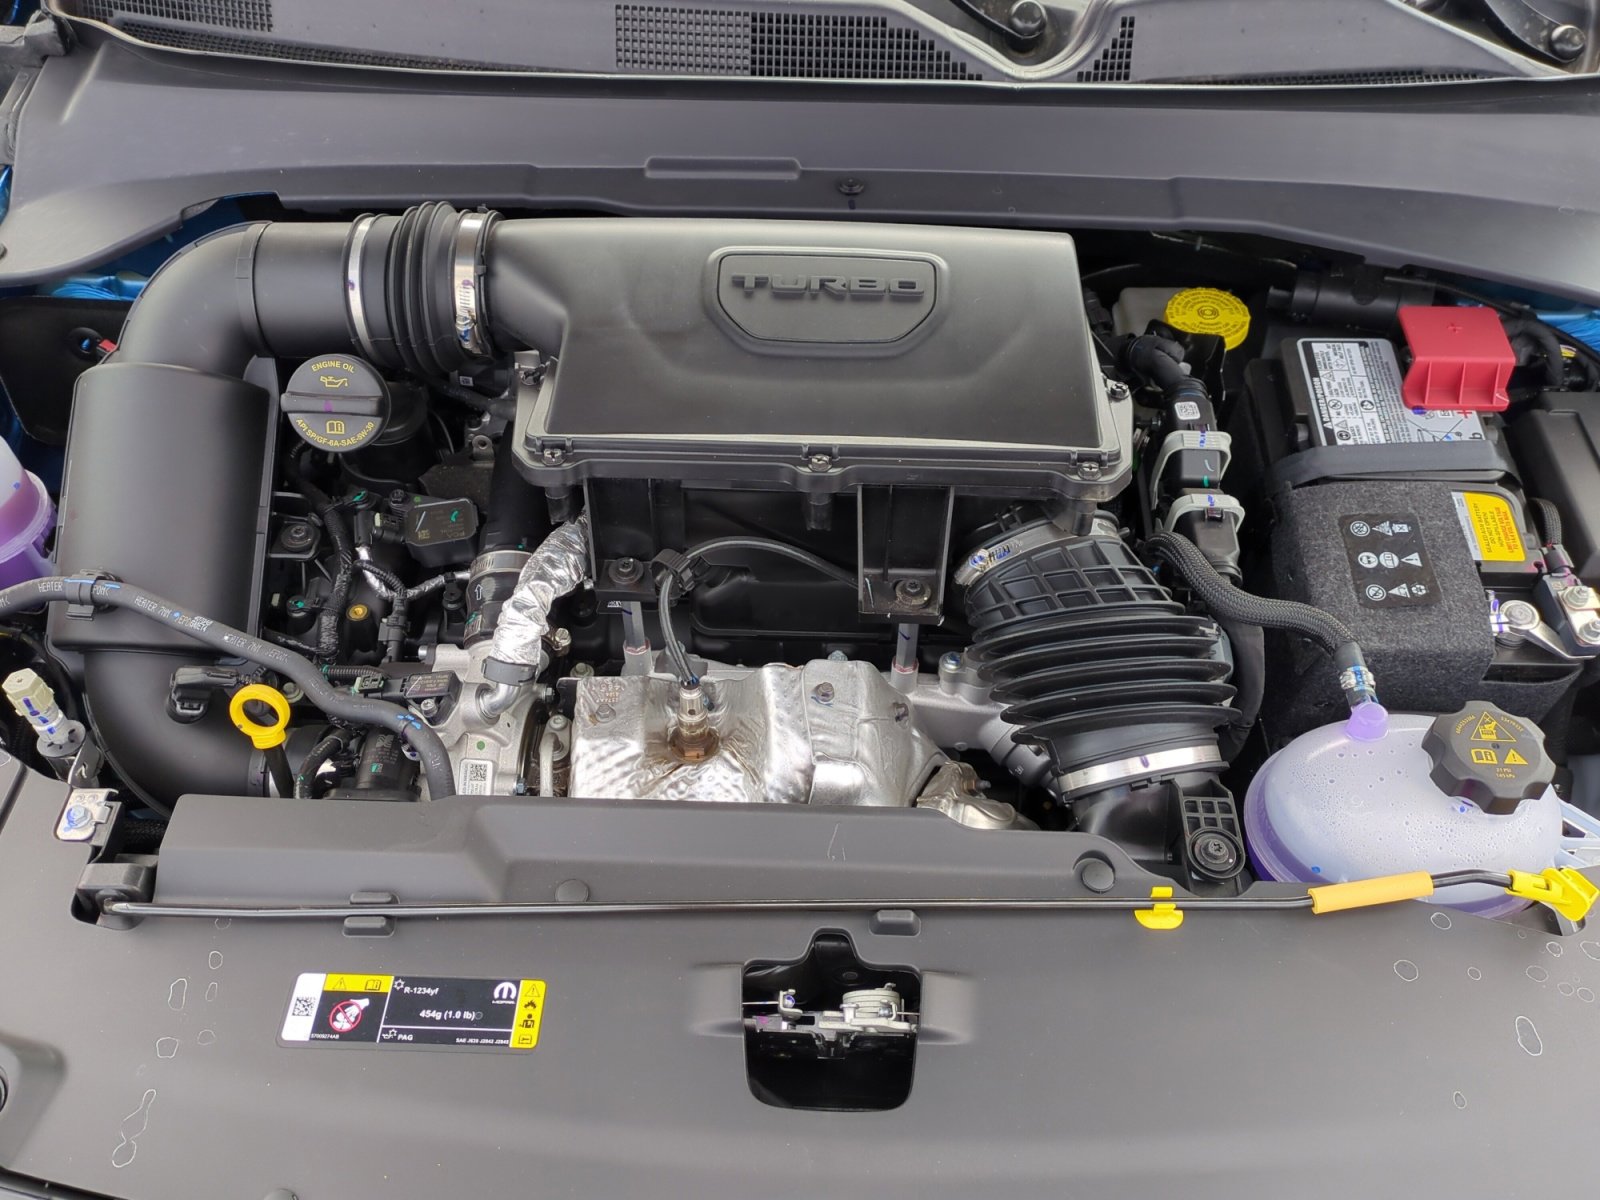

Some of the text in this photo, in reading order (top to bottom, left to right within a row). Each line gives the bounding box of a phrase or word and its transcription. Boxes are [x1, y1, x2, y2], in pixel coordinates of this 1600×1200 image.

[731, 273, 924, 300] TURBO
[311, 360, 355, 374] ENGINE OIL
[296, 419, 307, 432] API
[38, 581, 63, 592] HEATER
[134, 595, 158, 612] HEATER
[403, 986, 439, 995] R-1234yf
[419, 1010, 476, 1020] 454g (1.0 lb)
